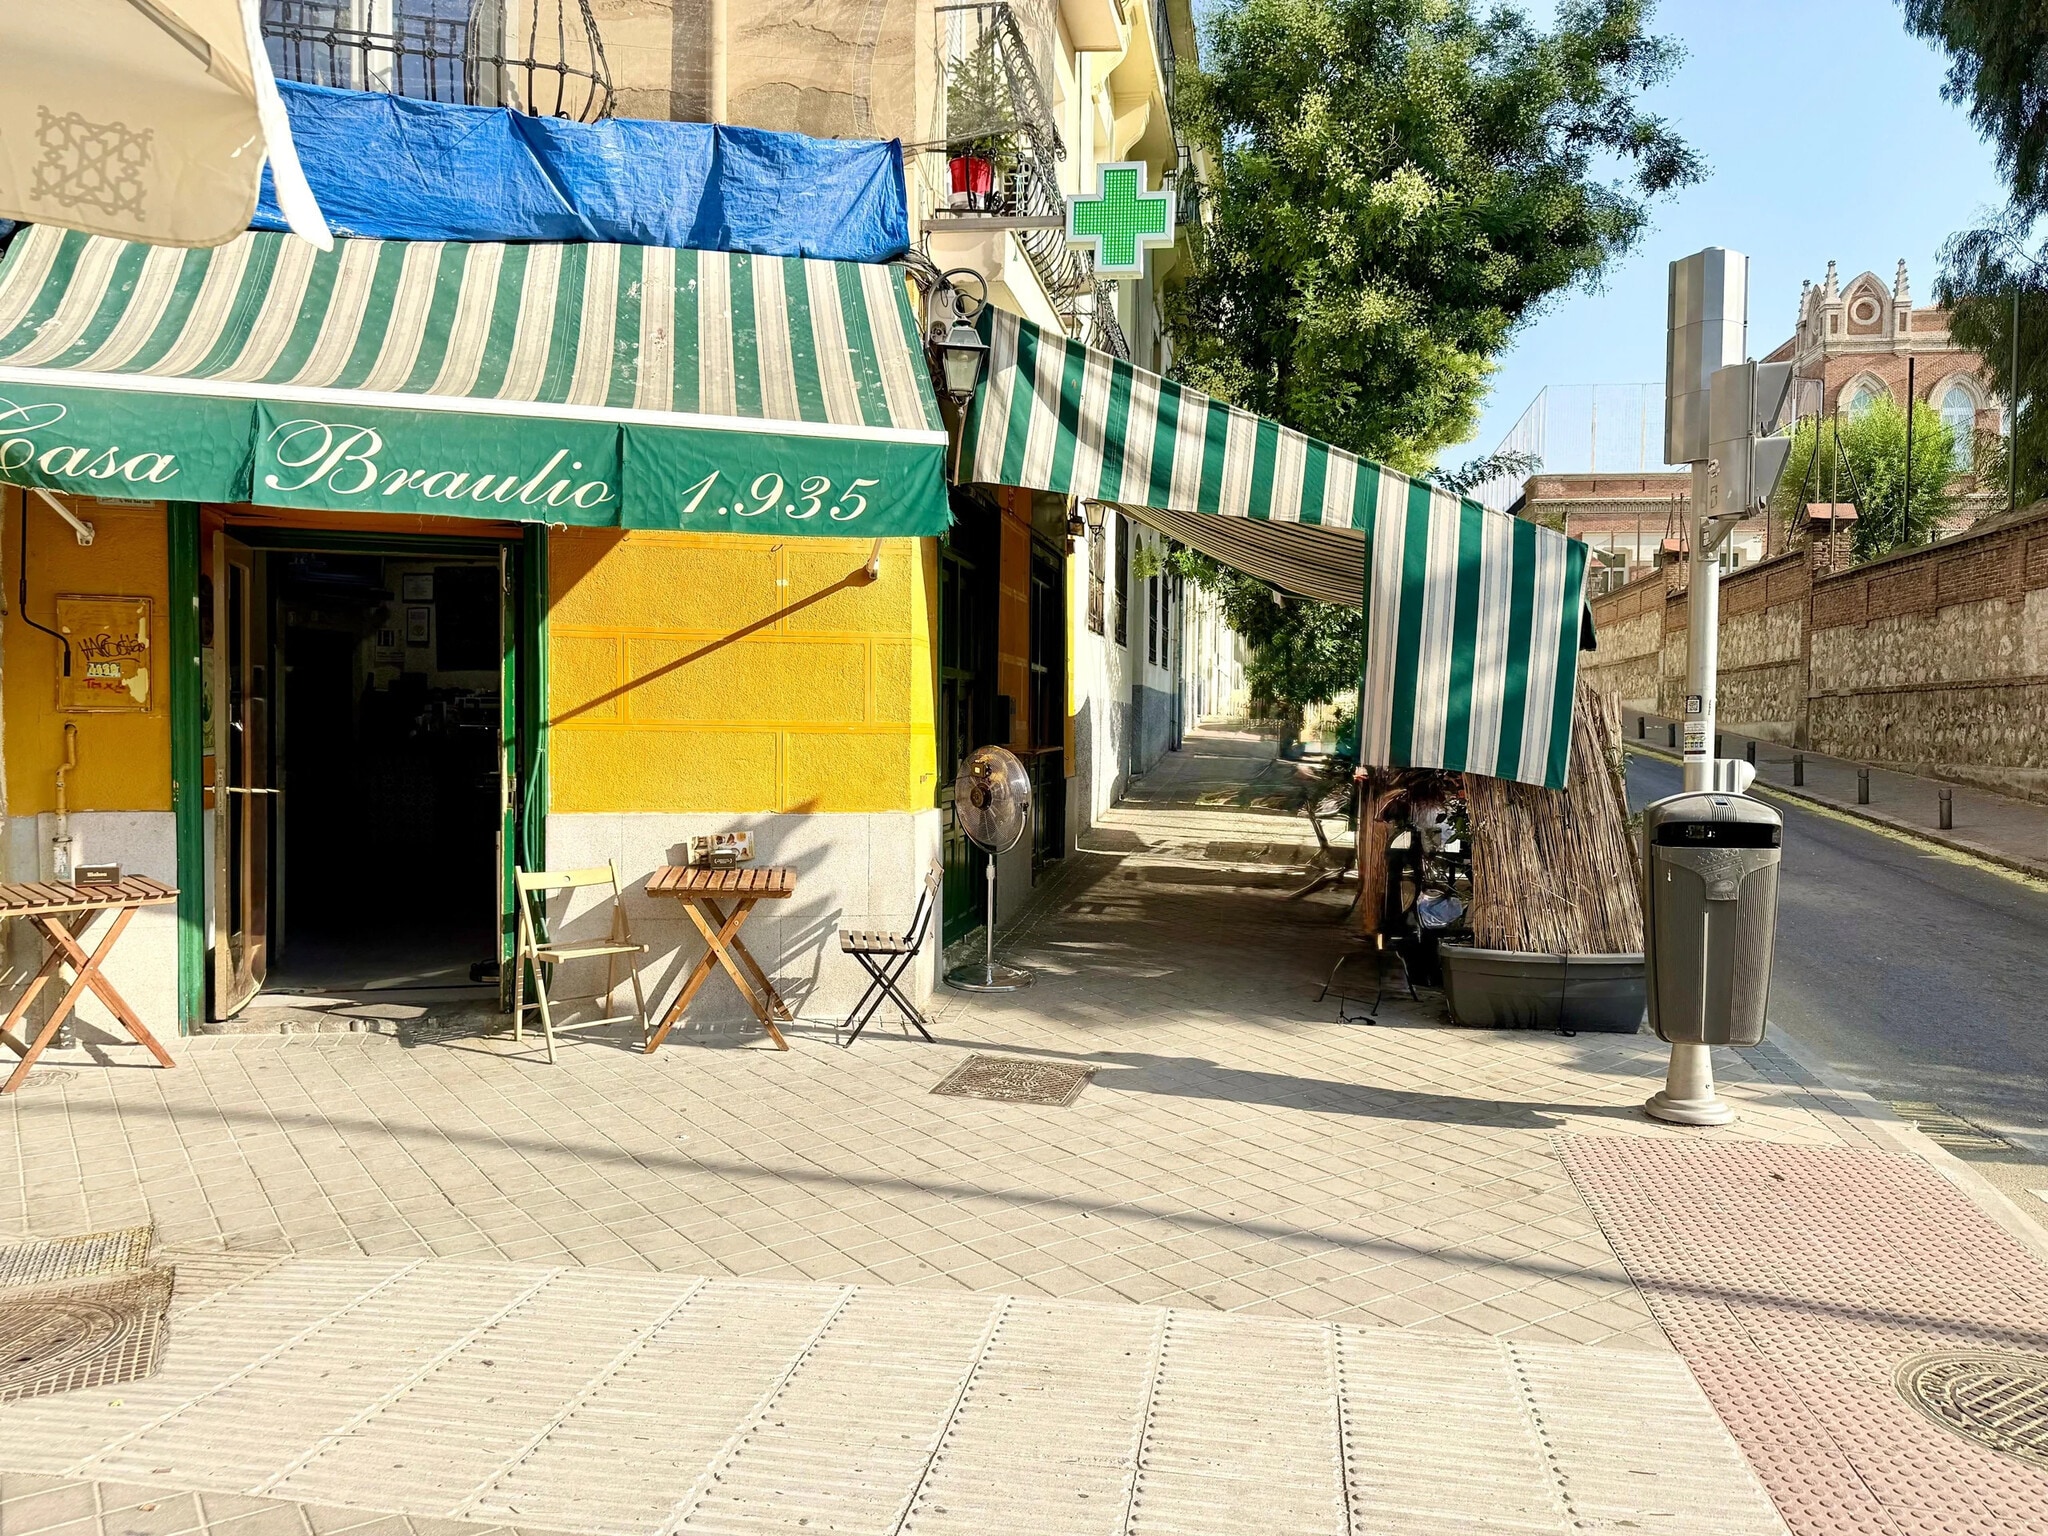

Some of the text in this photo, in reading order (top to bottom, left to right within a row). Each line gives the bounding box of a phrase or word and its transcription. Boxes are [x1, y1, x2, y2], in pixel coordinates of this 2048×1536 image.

[0, 397, 880, 521] Casa Braulio 1.935
